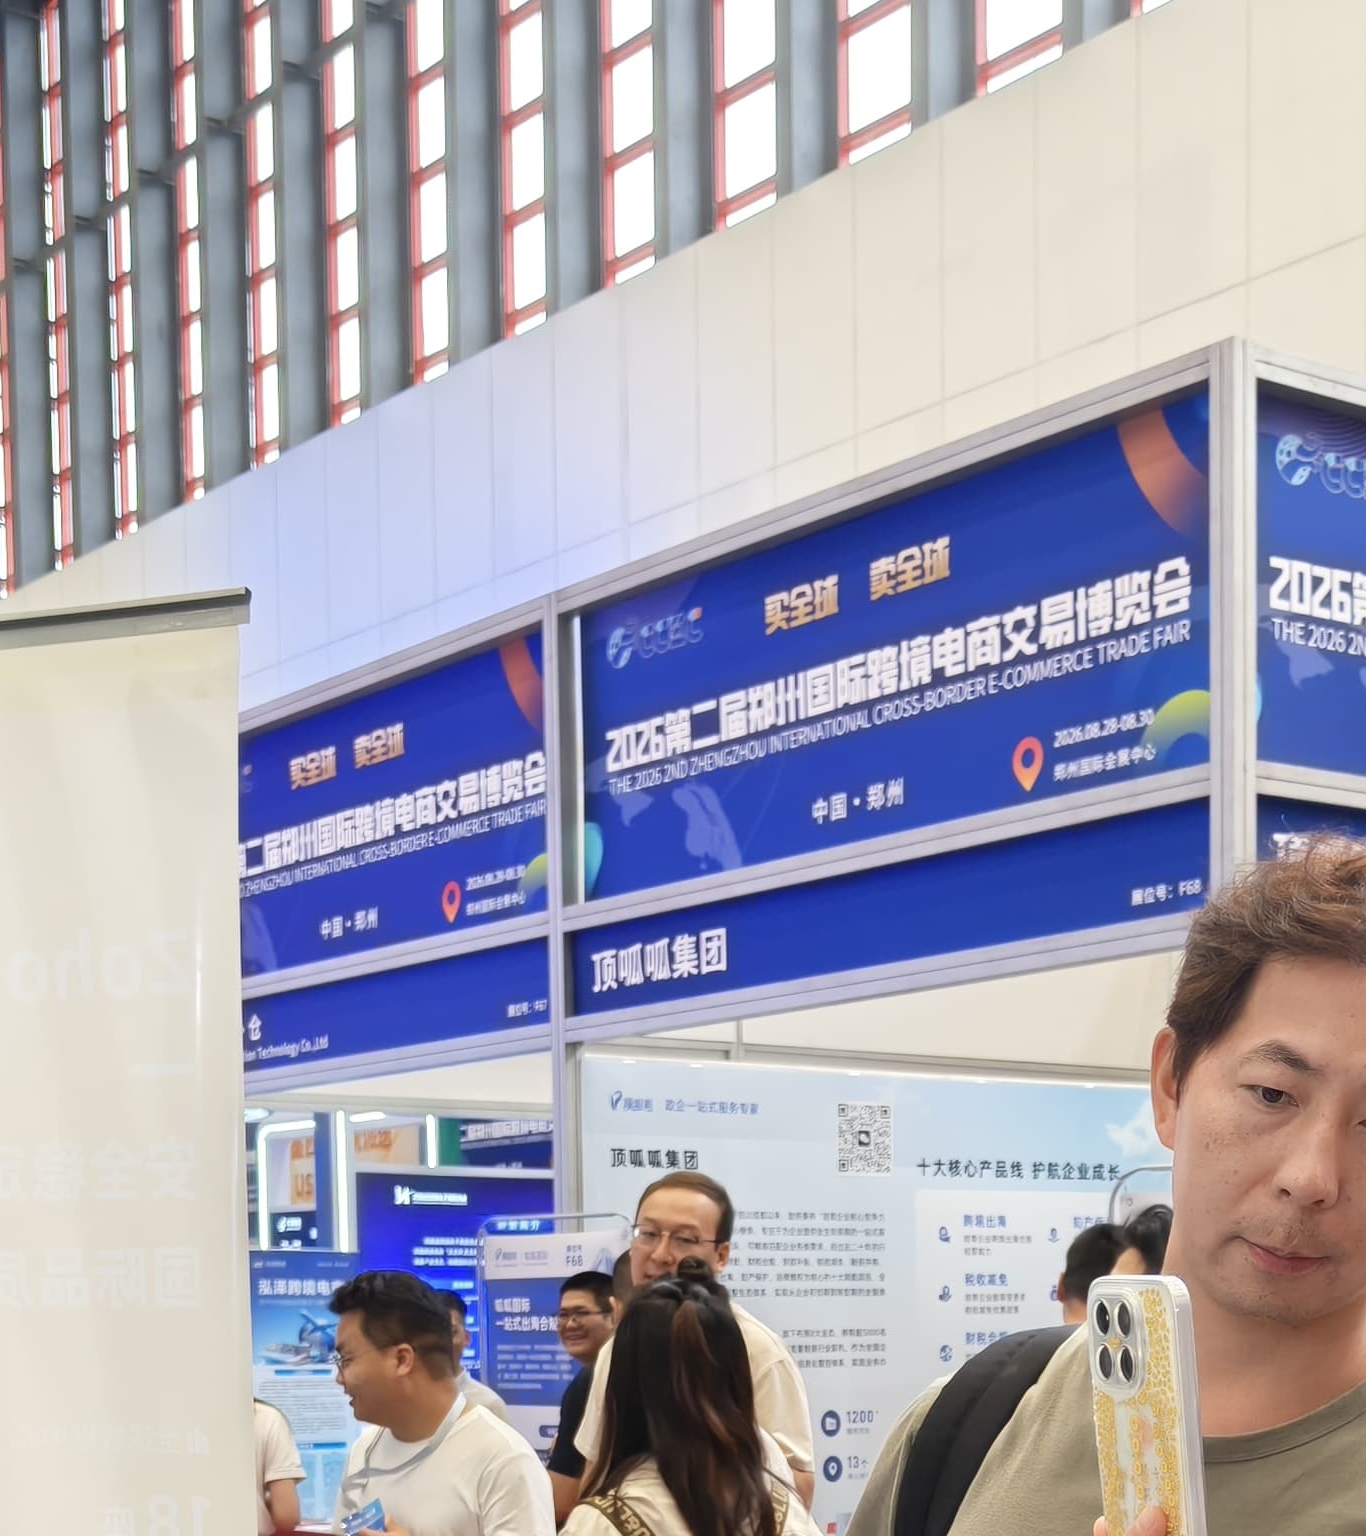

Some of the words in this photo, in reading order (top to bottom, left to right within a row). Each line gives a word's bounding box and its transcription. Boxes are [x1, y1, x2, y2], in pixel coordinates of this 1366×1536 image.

[763, 573, 840, 636] 买全球
[868, 535, 951, 601] 卖全球
[605, 555, 1192, 773] 2026第二届郑州国际跨境电商交易博览会
[1271, 617, 1306, 645] THE
[1308, 625, 1347, 652] 2026
[609, 773, 633, 796] THE
[634, 766, 662, 790] 2026
[663, 760, 689, 783] 2ND
[689, 738, 767, 777] ZHENGZHOU
[768, 716, 871, 754] INTERNATIONAL
[871, 676, 986, 725] CROSS-BORDER
[988, 651, 1094, 694] E-COMMERCE
[1098, 634, 1150, 664] TRADE
[1152, 620, 1192, 650] FAIR
[288, 745, 337, 791] 买全球
[353, 722, 406, 769] 卖全球
[590, 927, 728, 994] 顶呱呱集团
[610, 1147, 699, 1171] 顶呱呱集团
[916, 1158, 1025, 1179] 十大核心产品线
[1031, 1161, 1121, 1183] 护航企业成长
